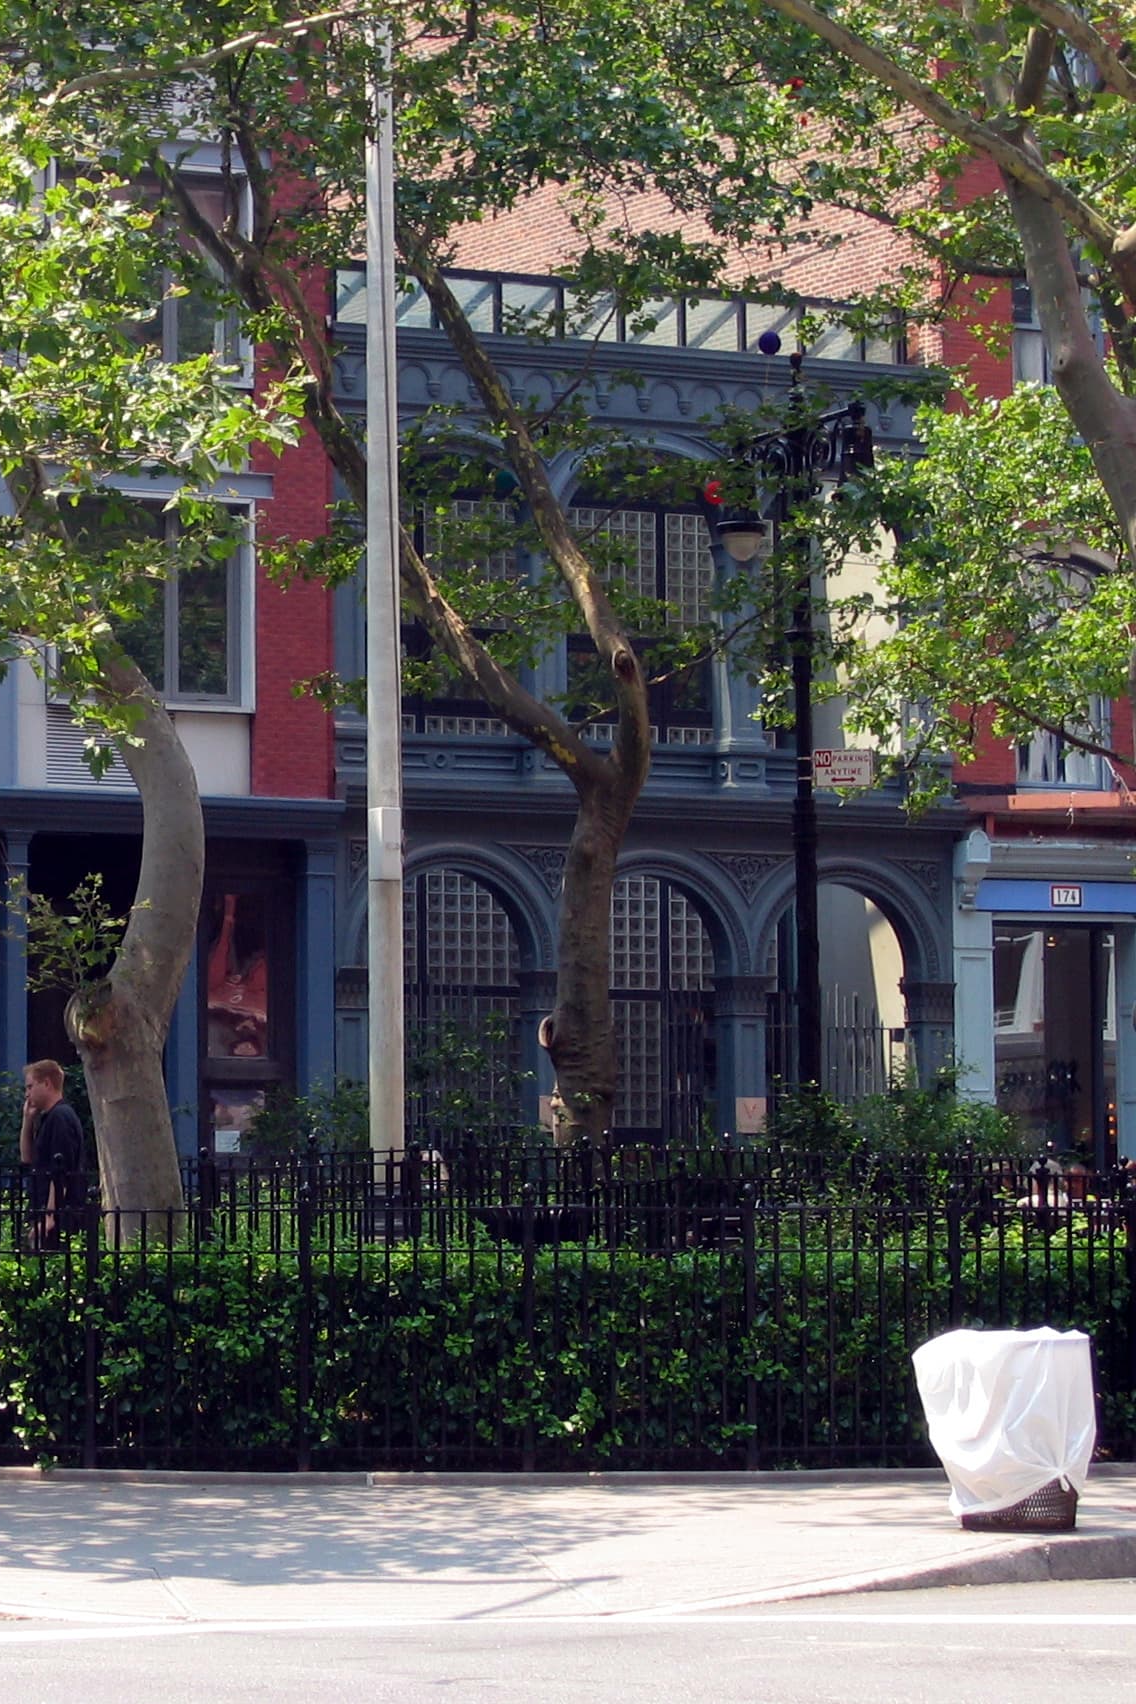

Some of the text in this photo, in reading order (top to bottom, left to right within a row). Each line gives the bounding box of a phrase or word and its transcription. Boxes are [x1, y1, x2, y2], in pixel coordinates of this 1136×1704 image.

[815, 752, 831, 766] NO
[824, 767, 863, 776] ANYTIME
[1057, 889, 1077, 903] 174
